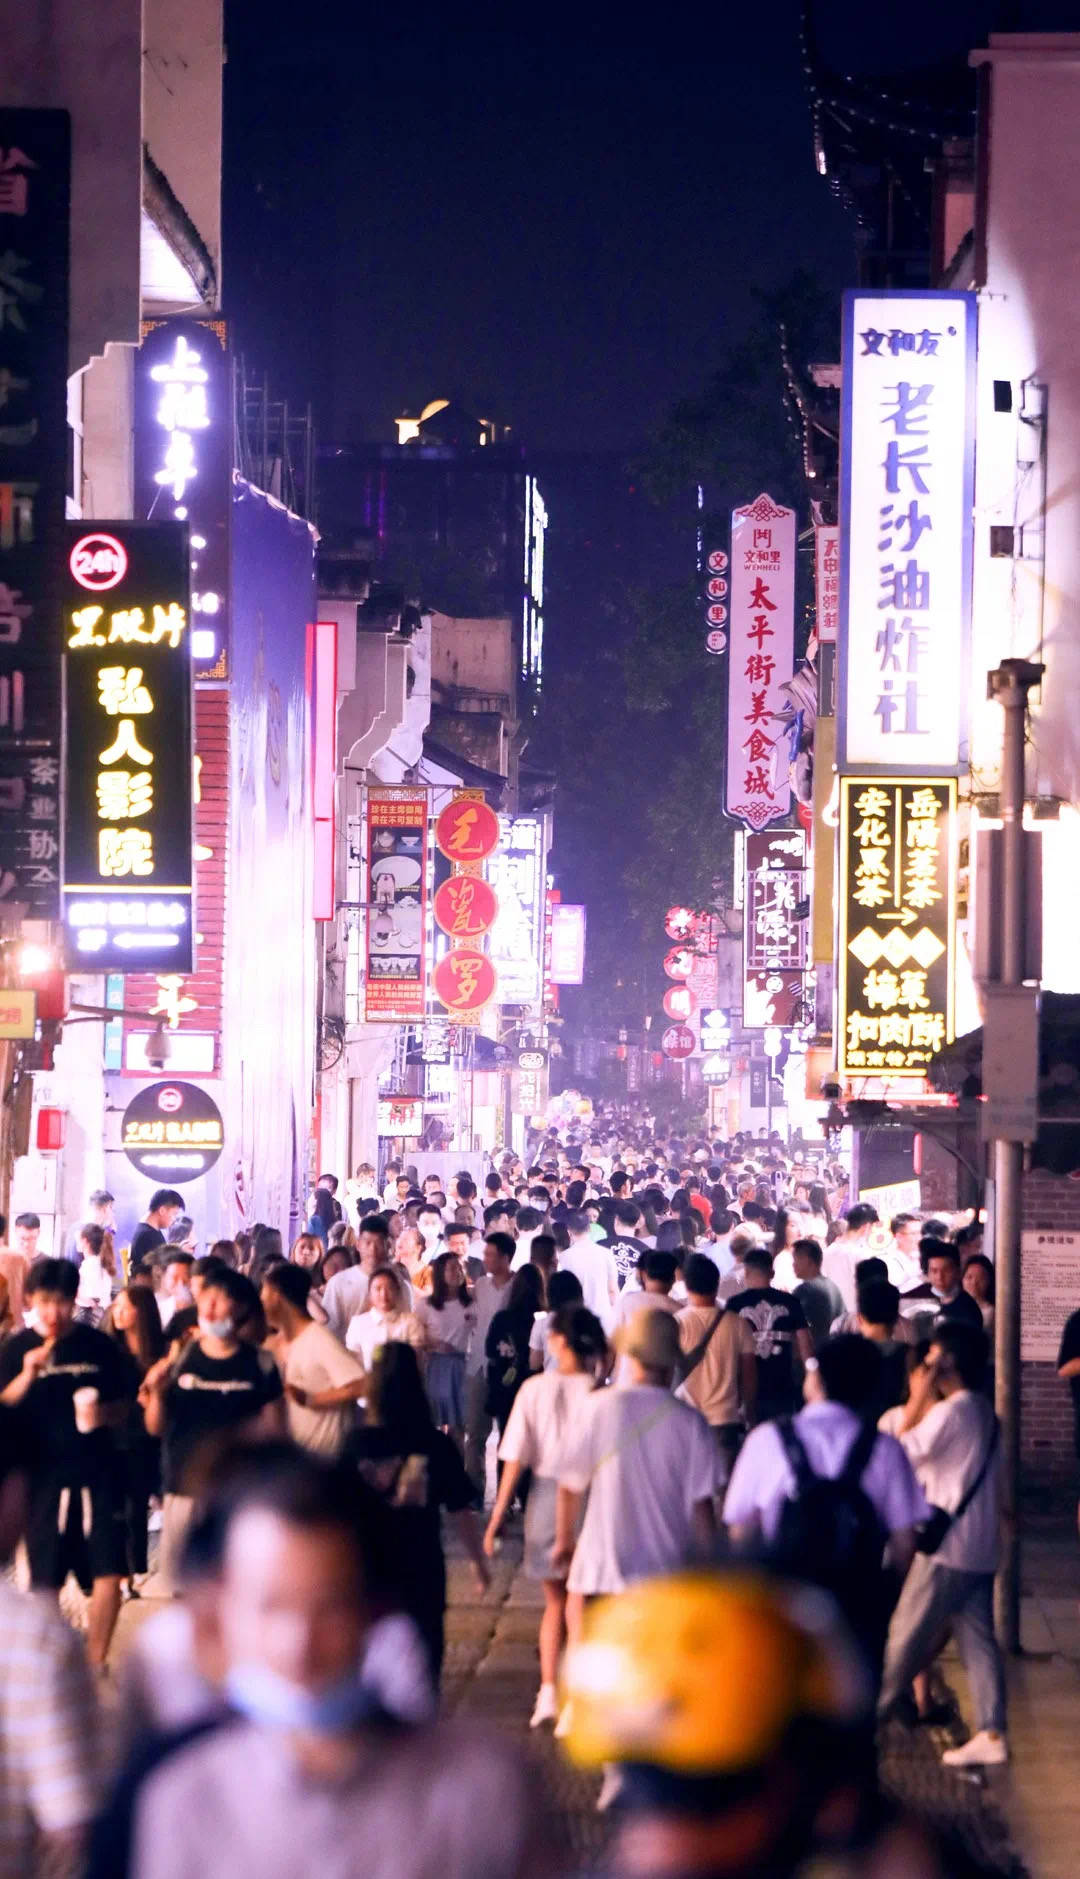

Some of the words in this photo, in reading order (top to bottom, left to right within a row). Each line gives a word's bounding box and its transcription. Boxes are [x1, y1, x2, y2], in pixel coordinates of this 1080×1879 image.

[857, 327, 943, 357] 文和友
[76, 549, 119, 575] 24h
[711, 552, 726, 621] 文和里
[744, 549, 781, 563] 文和里
[873, 381, 935, 734] 老长沙油炸社
[743, 576, 778, 800] 太平街美食城
[96, 666, 154, 877] 私人影院
[853, 787, 892, 908] 安化黑茶
[847, 1050, 933, 1067] 湖南特产
